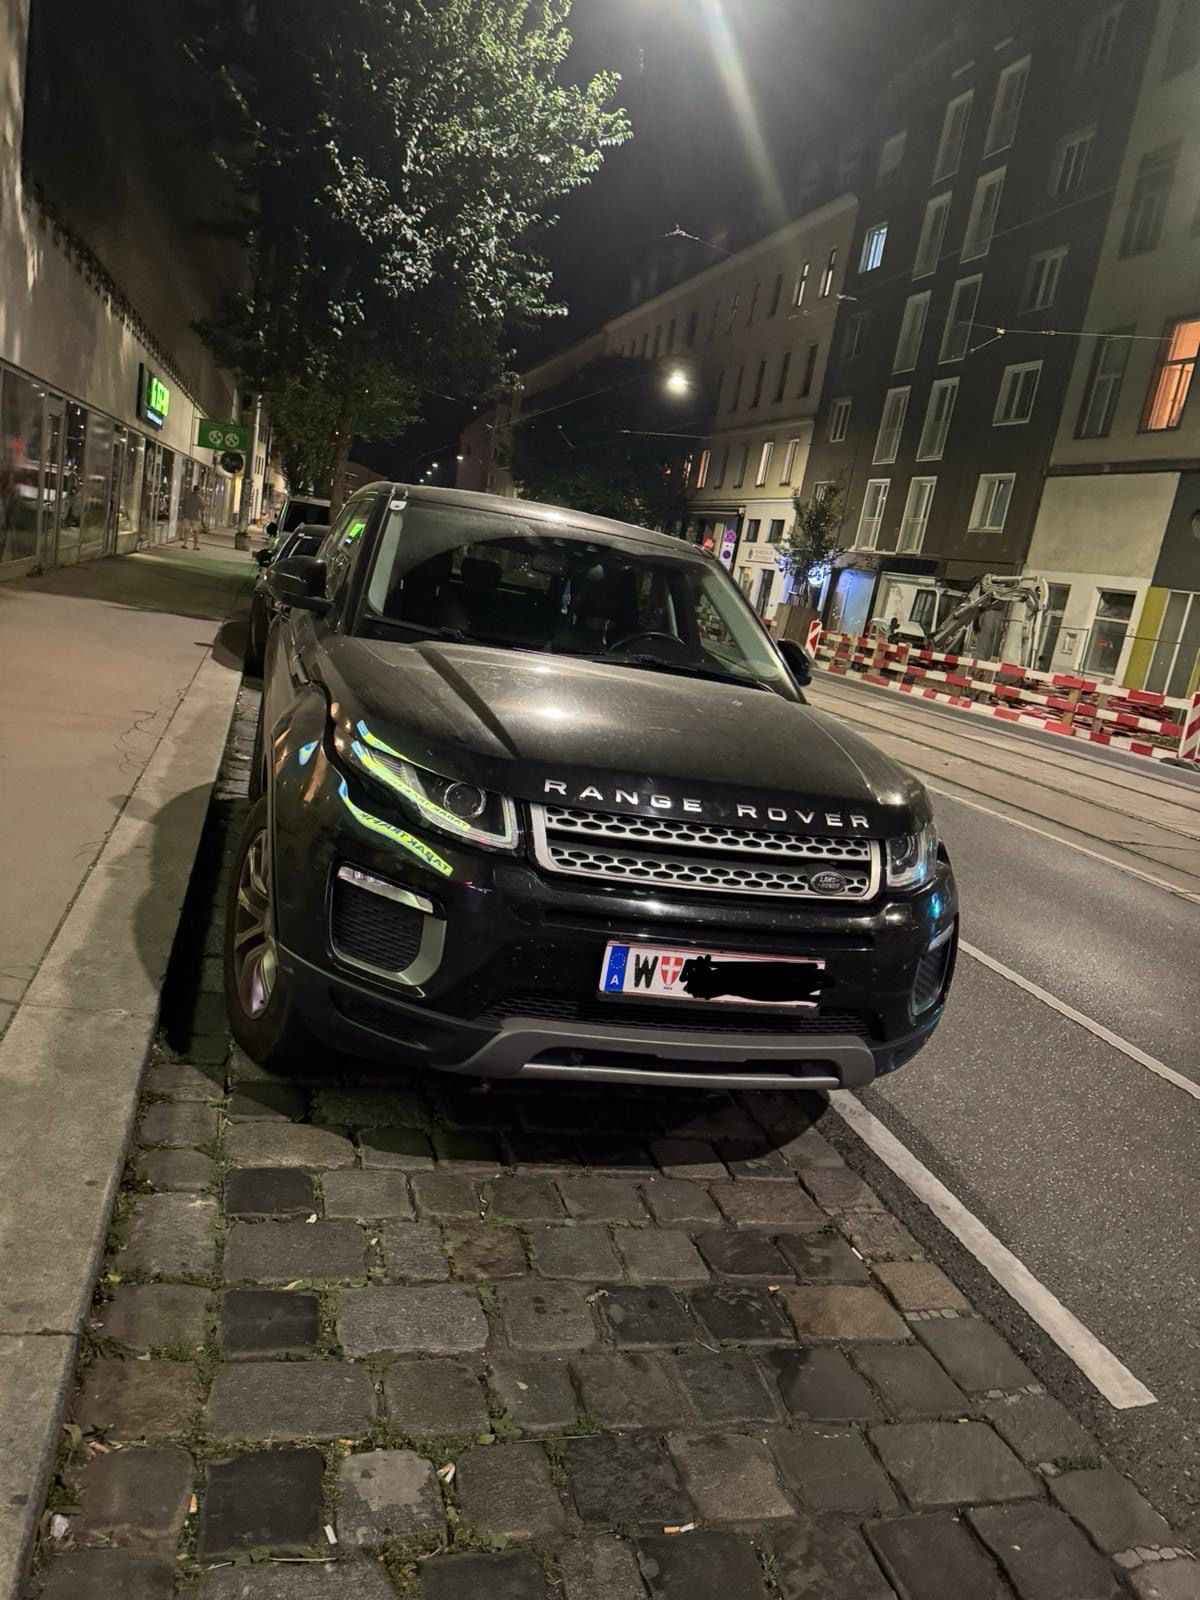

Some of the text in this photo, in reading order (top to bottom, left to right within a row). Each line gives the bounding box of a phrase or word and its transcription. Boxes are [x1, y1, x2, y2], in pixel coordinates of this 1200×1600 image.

[543, 778, 870, 829] RANGE ROVER
[610, 974, 620, 986] A
[634, 953, 660, 989] W
